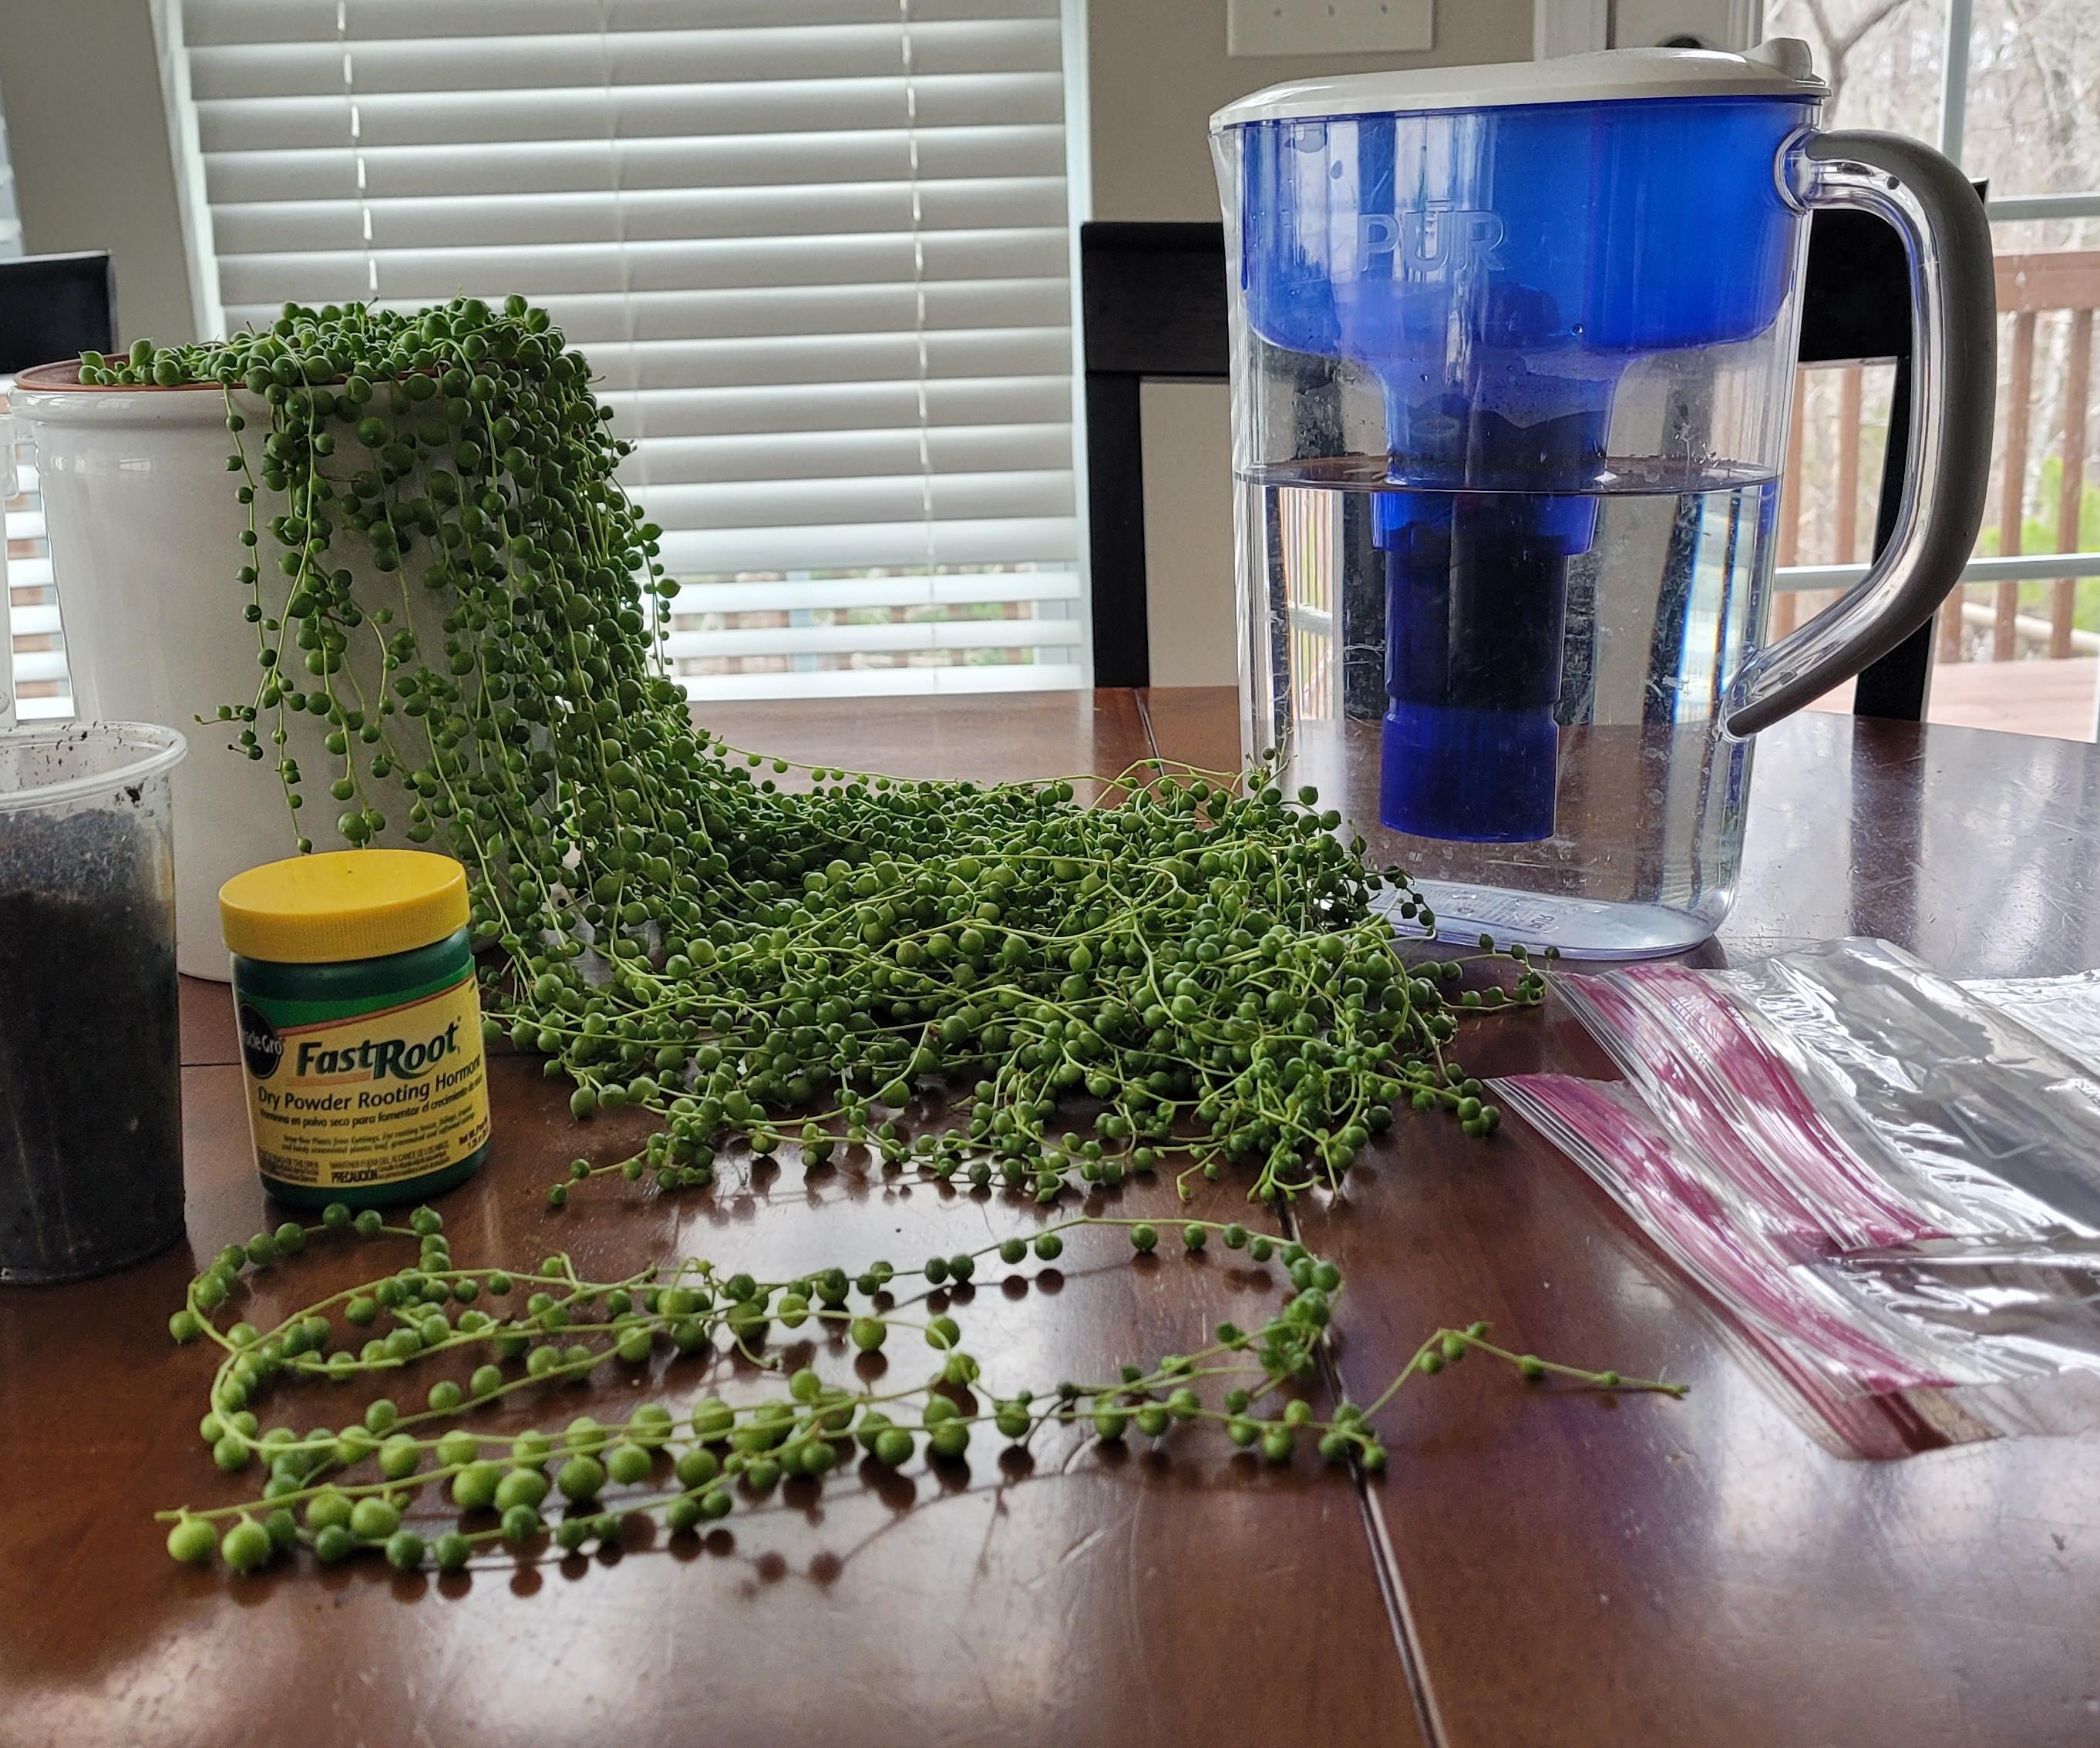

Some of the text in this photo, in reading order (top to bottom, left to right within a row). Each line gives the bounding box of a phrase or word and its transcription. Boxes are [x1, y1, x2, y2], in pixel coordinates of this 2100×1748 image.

[296, 1021, 459, 1080] FastRoot
[258, 1085, 281, 1111] Dry
[284, 1092, 352, 1111] Powder
[358, 1082, 430, 1109] Rooting
[352, 1116, 375, 1129] para
[379, 1106, 420, 1123] fomentar
